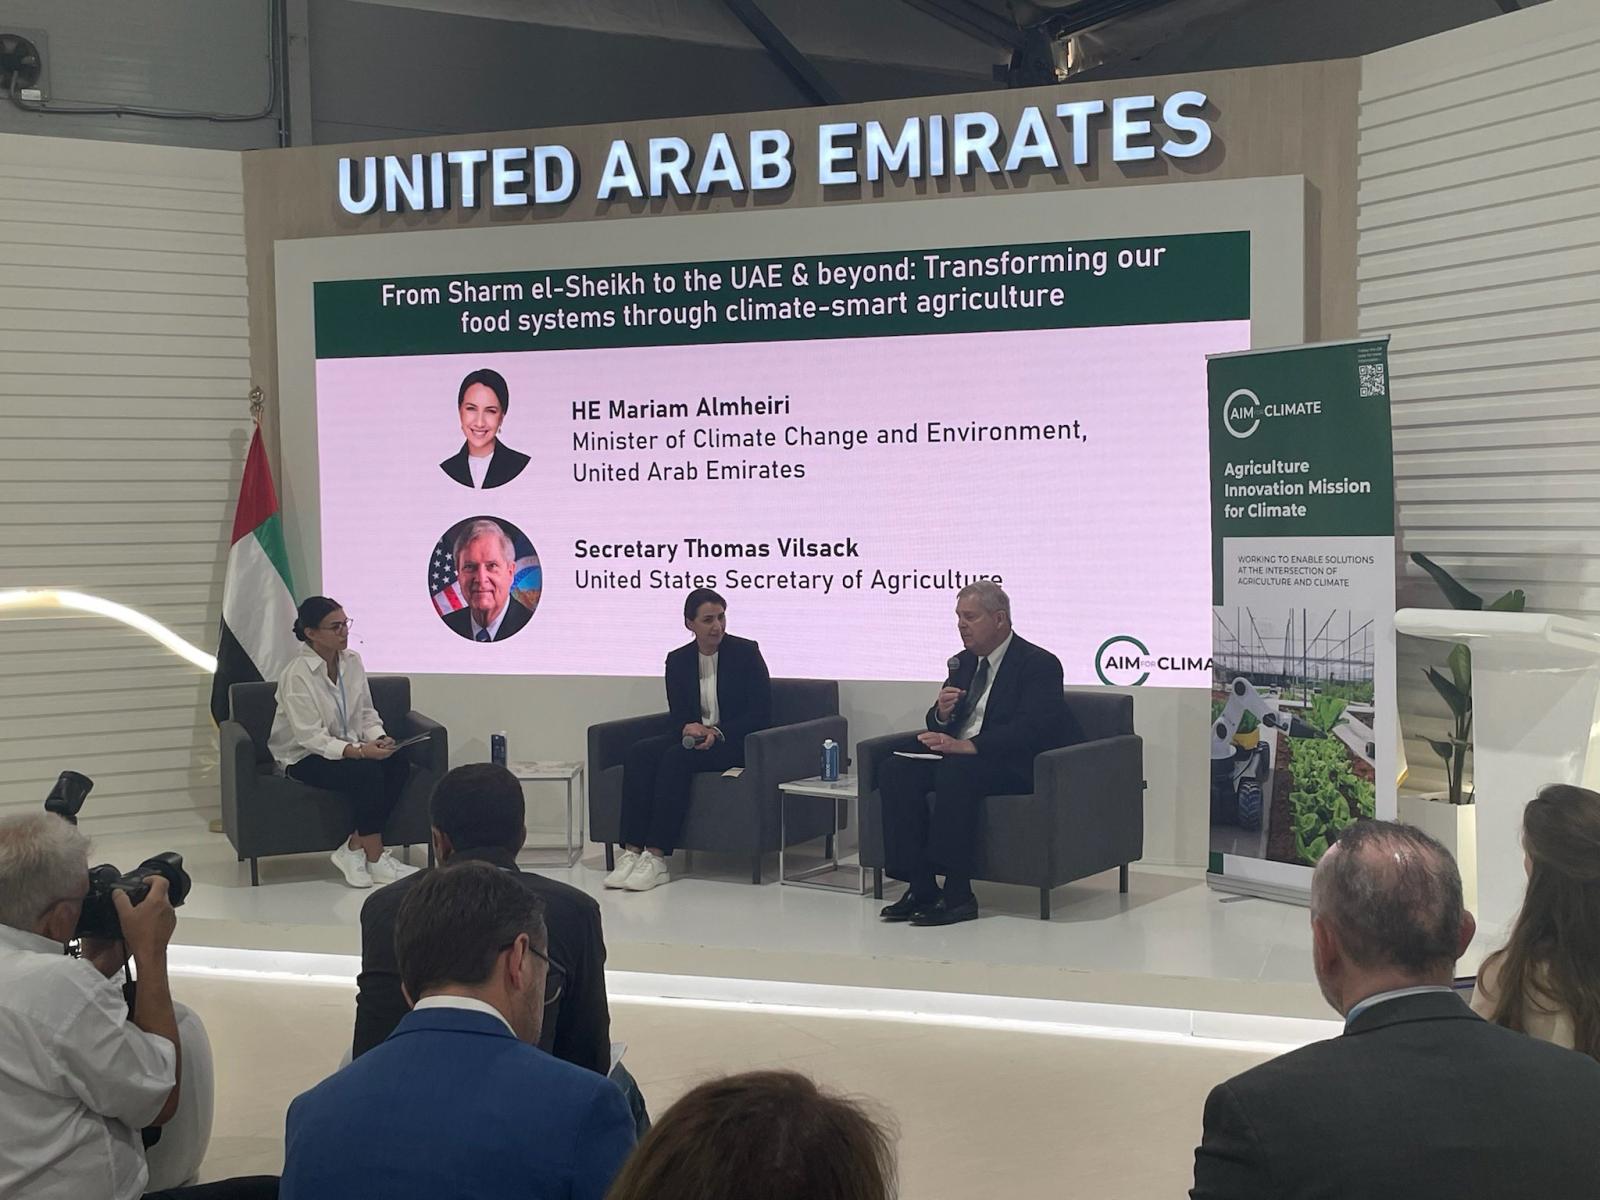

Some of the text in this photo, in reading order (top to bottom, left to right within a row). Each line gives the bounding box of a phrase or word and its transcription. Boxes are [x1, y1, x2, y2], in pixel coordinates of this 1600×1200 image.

[338, 91, 1212, 214] UNITED ARAB EMIRATES
[382, 247, 1166, 306] From Sharm el-Sheikh to the UAE & beyond: Transforming our
[461, 285, 1065, 336] food systems through climate-smart agriculture
[572, 395, 790, 420] HE Mariam Almheiri
[1230, 401, 1322, 420] AIM CLIMATE
[573, 420, 1087, 450] Minister of Climate Change and Environment,
[573, 460, 806, 482] United Arab Emirates
[1224, 460, 1310, 479] Agriculture
[1224, 478, 1371, 497] Innovation Mission
[1224, 503, 1307, 518] for Climate
[574, 537, 859, 563] Secretary Thomas Vilsack
[1238, 555, 1375, 565] WORKING TO ENABLE SOLUTIONS
[1238, 566, 1337, 575] AT THE INTERSECTION OF
[575, 570, 641, 589] United
[650, 570, 717, 589] States
[725, 570, 834, 594] Secretary
[842, 569, 862, 589] of
[1238, 577, 1350, 588] AGRICULTURE AND CLIMATE
[1105, 656, 1140, 670] AIM
